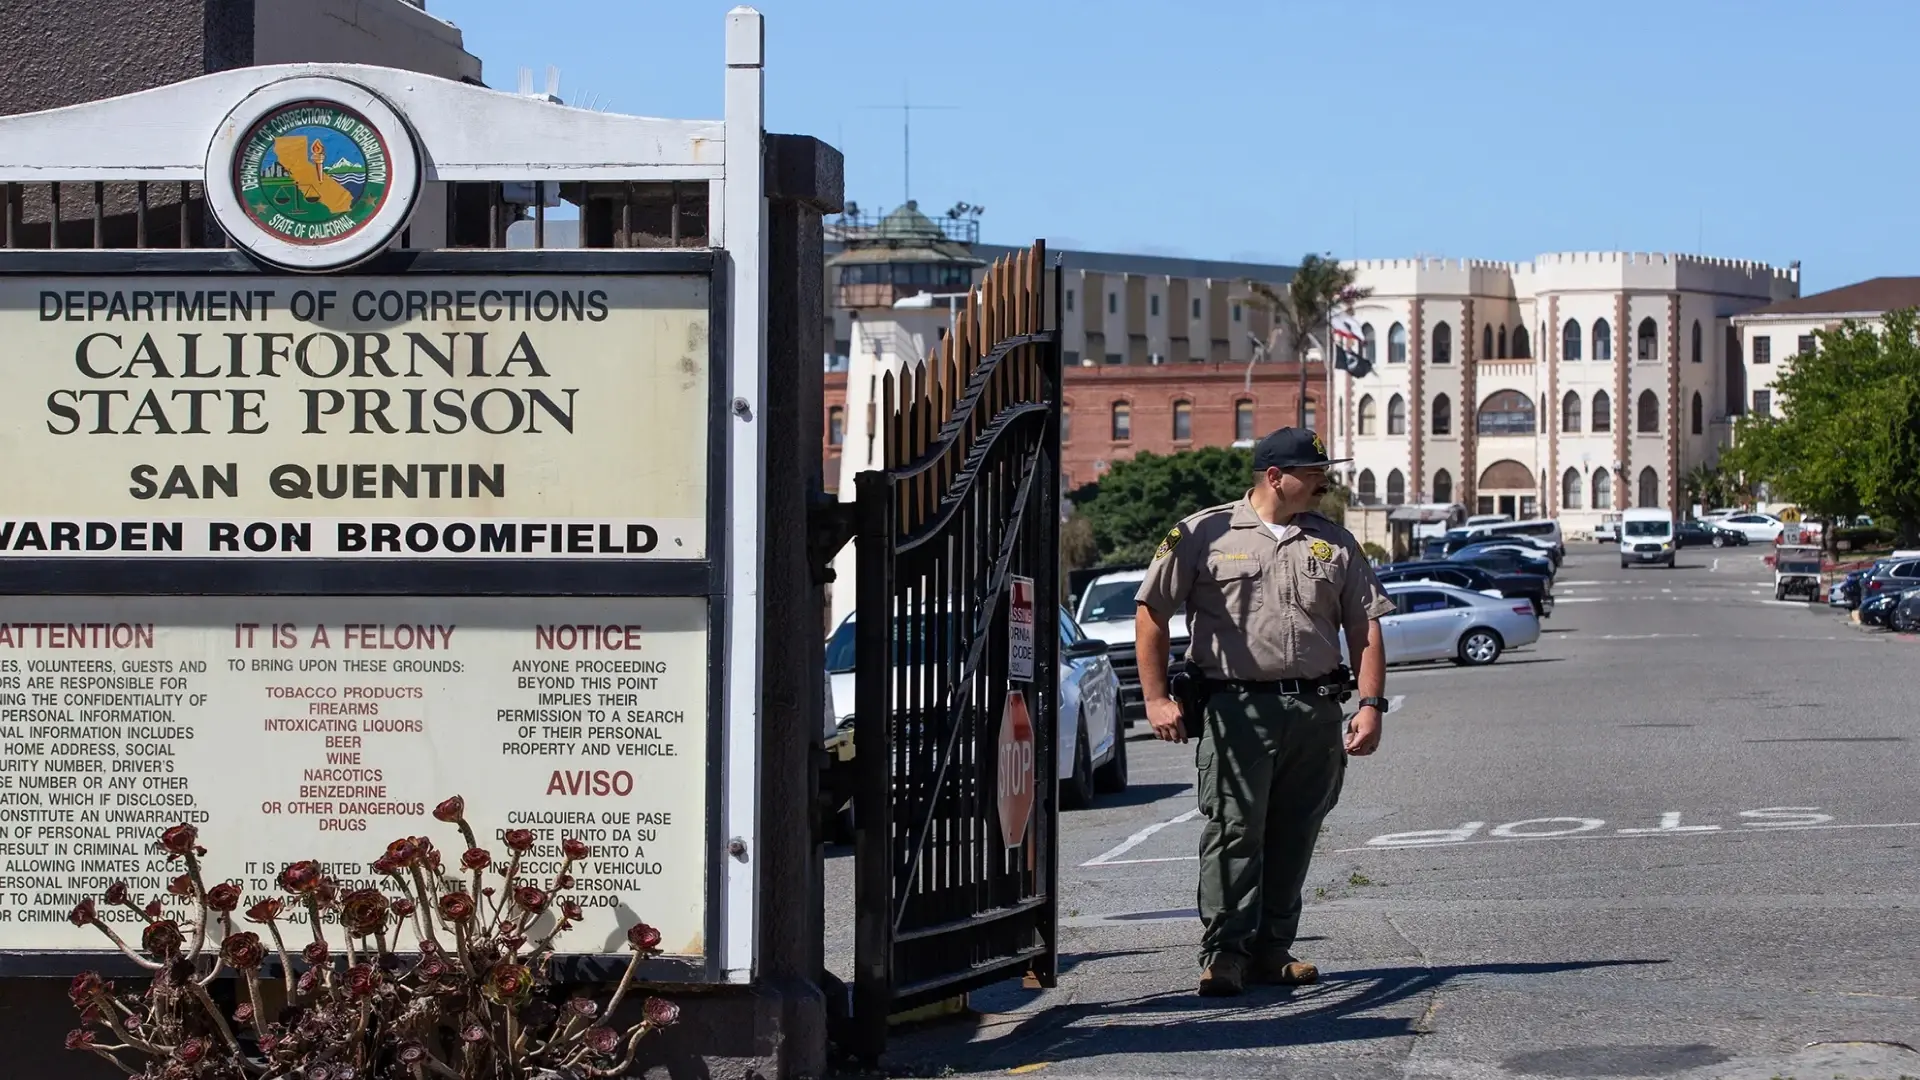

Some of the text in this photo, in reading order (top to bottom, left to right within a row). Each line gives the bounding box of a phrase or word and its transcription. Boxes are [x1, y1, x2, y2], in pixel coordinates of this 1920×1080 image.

[240, 107, 387, 191] DEPARTMENT OF CORRECTIONS AND REHABILITATION
[269, 214, 356, 239] STATE OF CALIFORNIA
[40, 290, 609, 322] DEPARTMENT OF CORRECTIONS
[76, 332, 551, 378] CALIFORNIA
[47, 388, 579, 435] STATE PRISON
[130, 463, 504, 499] SAN QUENTIN
[209, 522, 311, 552] RON
[338, 523, 658, 553] BROOMFIELD
[0, 623, 153, 648] ATTENTION
[236, 623, 456, 649] IT IS A FELONY
[536, 624, 641, 650] NOTICE
[1012, 645, 1032, 659] CODE
[27, 660, 115, 672] VOLUNTEERS,
[122, 660, 173, 673] GUESTS
[179, 661, 206, 672] AND
[228, 659, 464, 672] TO BRING UPON THESE GROUNDS:
[512, 660, 666, 673] ANYONE PROCEEDING
[27, 677, 54, 689] ARE
[61, 677, 153, 689] RESPONSIBLE
[160, 677, 187, 689] FOR
[518, 677, 658, 689] BEYOND THIS POINT
[265, 687, 423, 698] TOBACCO PRODUCTS
[32, 694, 57, 705] THE
[64, 694, 183, 706] CONFIDENTIALITY
[189, 694, 207, 706] OF
[539, 693, 637, 706] IMPLIES THEIR
[310, 703, 378, 715] FIREARMS
[2, 710, 175, 722] PERSONAL INFORMATION.
[498, 710, 683, 723] PERMISSION TO A SEARCH
[265, 719, 422, 732] INTOXICATING LIQUORS
[30, 726, 121, 739] INFORMATION
[128, 727, 194, 739] INCLUDES
[518, 726, 662, 739] OF THEIR PERSONAL
[326, 736, 361, 748] BEER
[5, 743, 175, 756] HOME ADDRESS, SOCIAL
[503, 743, 677, 756] PROPERTY AND VEHICLE.
[327, 753, 360, 764] WINE
[45, 760, 106, 772] NUMBER,
[113, 760, 174, 772] DRIVER'S
[999, 741, 1032, 797] STOP
[304, 769, 382, 781] NARCOTICS
[20, 776, 76, 788] NUMBER
[83, 777, 102, 789] OR
[108, 777, 136, 789] ANY
[143, 777, 188, 789] OTHER
[547, 770, 633, 796] AVISO
[300, 786, 386, 798] BENZEDRINE
[0, 793, 197, 807] ATION, WHICH IF DISCLOSED,
[262, 802, 424, 815] OR OTHER DANGEROUS
[0, 810, 209, 823] ONSTITUTE AN UNWARRANTED
[508, 811, 671, 825] CUALQUIERA QUE PASE
[320, 819, 366, 831] DRUGS
[15, 826, 32, 838] OF
[39, 827, 110, 838] PERSONAL
[117, 827, 168, 838] PRIVAC
[562, 829, 606, 841] PUNTO
[613, 829, 631, 841] DA
[638, 829, 656, 841] SU
[55, 843, 67, 855] IN
[74, 843, 138, 855] CRIMINAL
[635, 846, 644, 858] A
[6, 860, 75, 872] ALLOWING
[81, 860, 139, 872] INMATES
[245, 862, 257, 874] IT
[262, 862, 275, 874] IS
[579, 862, 588, 874] Y
[594, 862, 662, 874] VEHICULO
[252, 879, 268, 890] TO
[10, 893, 27, 905] TO
